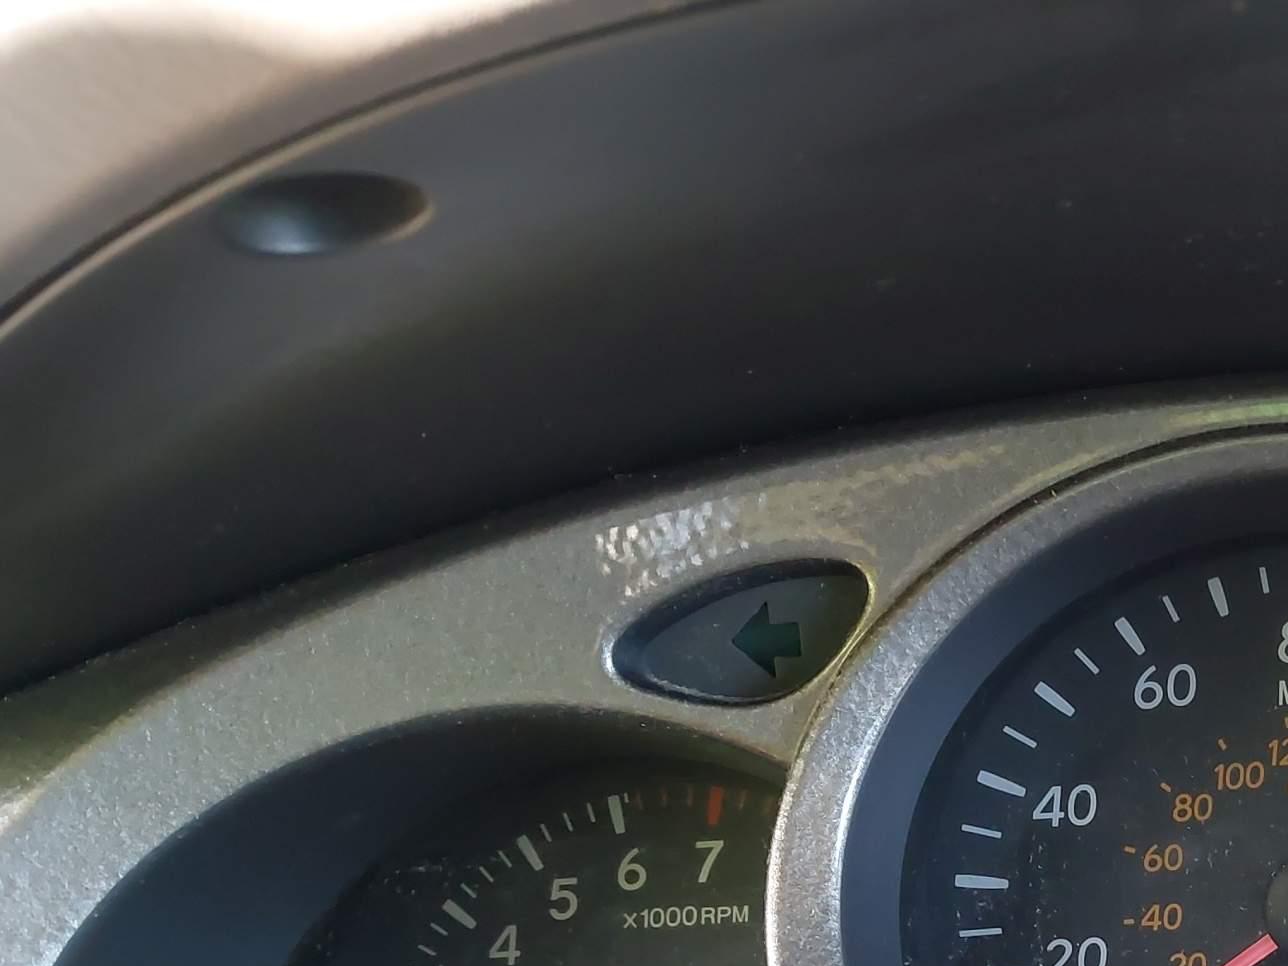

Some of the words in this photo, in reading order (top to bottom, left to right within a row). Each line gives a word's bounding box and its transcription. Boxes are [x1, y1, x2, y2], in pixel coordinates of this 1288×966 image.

[1134, 664, 1198, 710] 60
[1214, 761, 1265, 790] 100
[1032, 784, 1097, 827] 40
[1172, 794, 1213, 822] 80
[617, 848, 647, 890] 6
[696, 840, 724, 883] 7
[1143, 844, 1184, 872] 60
[549, 877, 578, 920] 5
[1141, 903, 1183, 931] 40
[489, 925, 520, 965] 4
